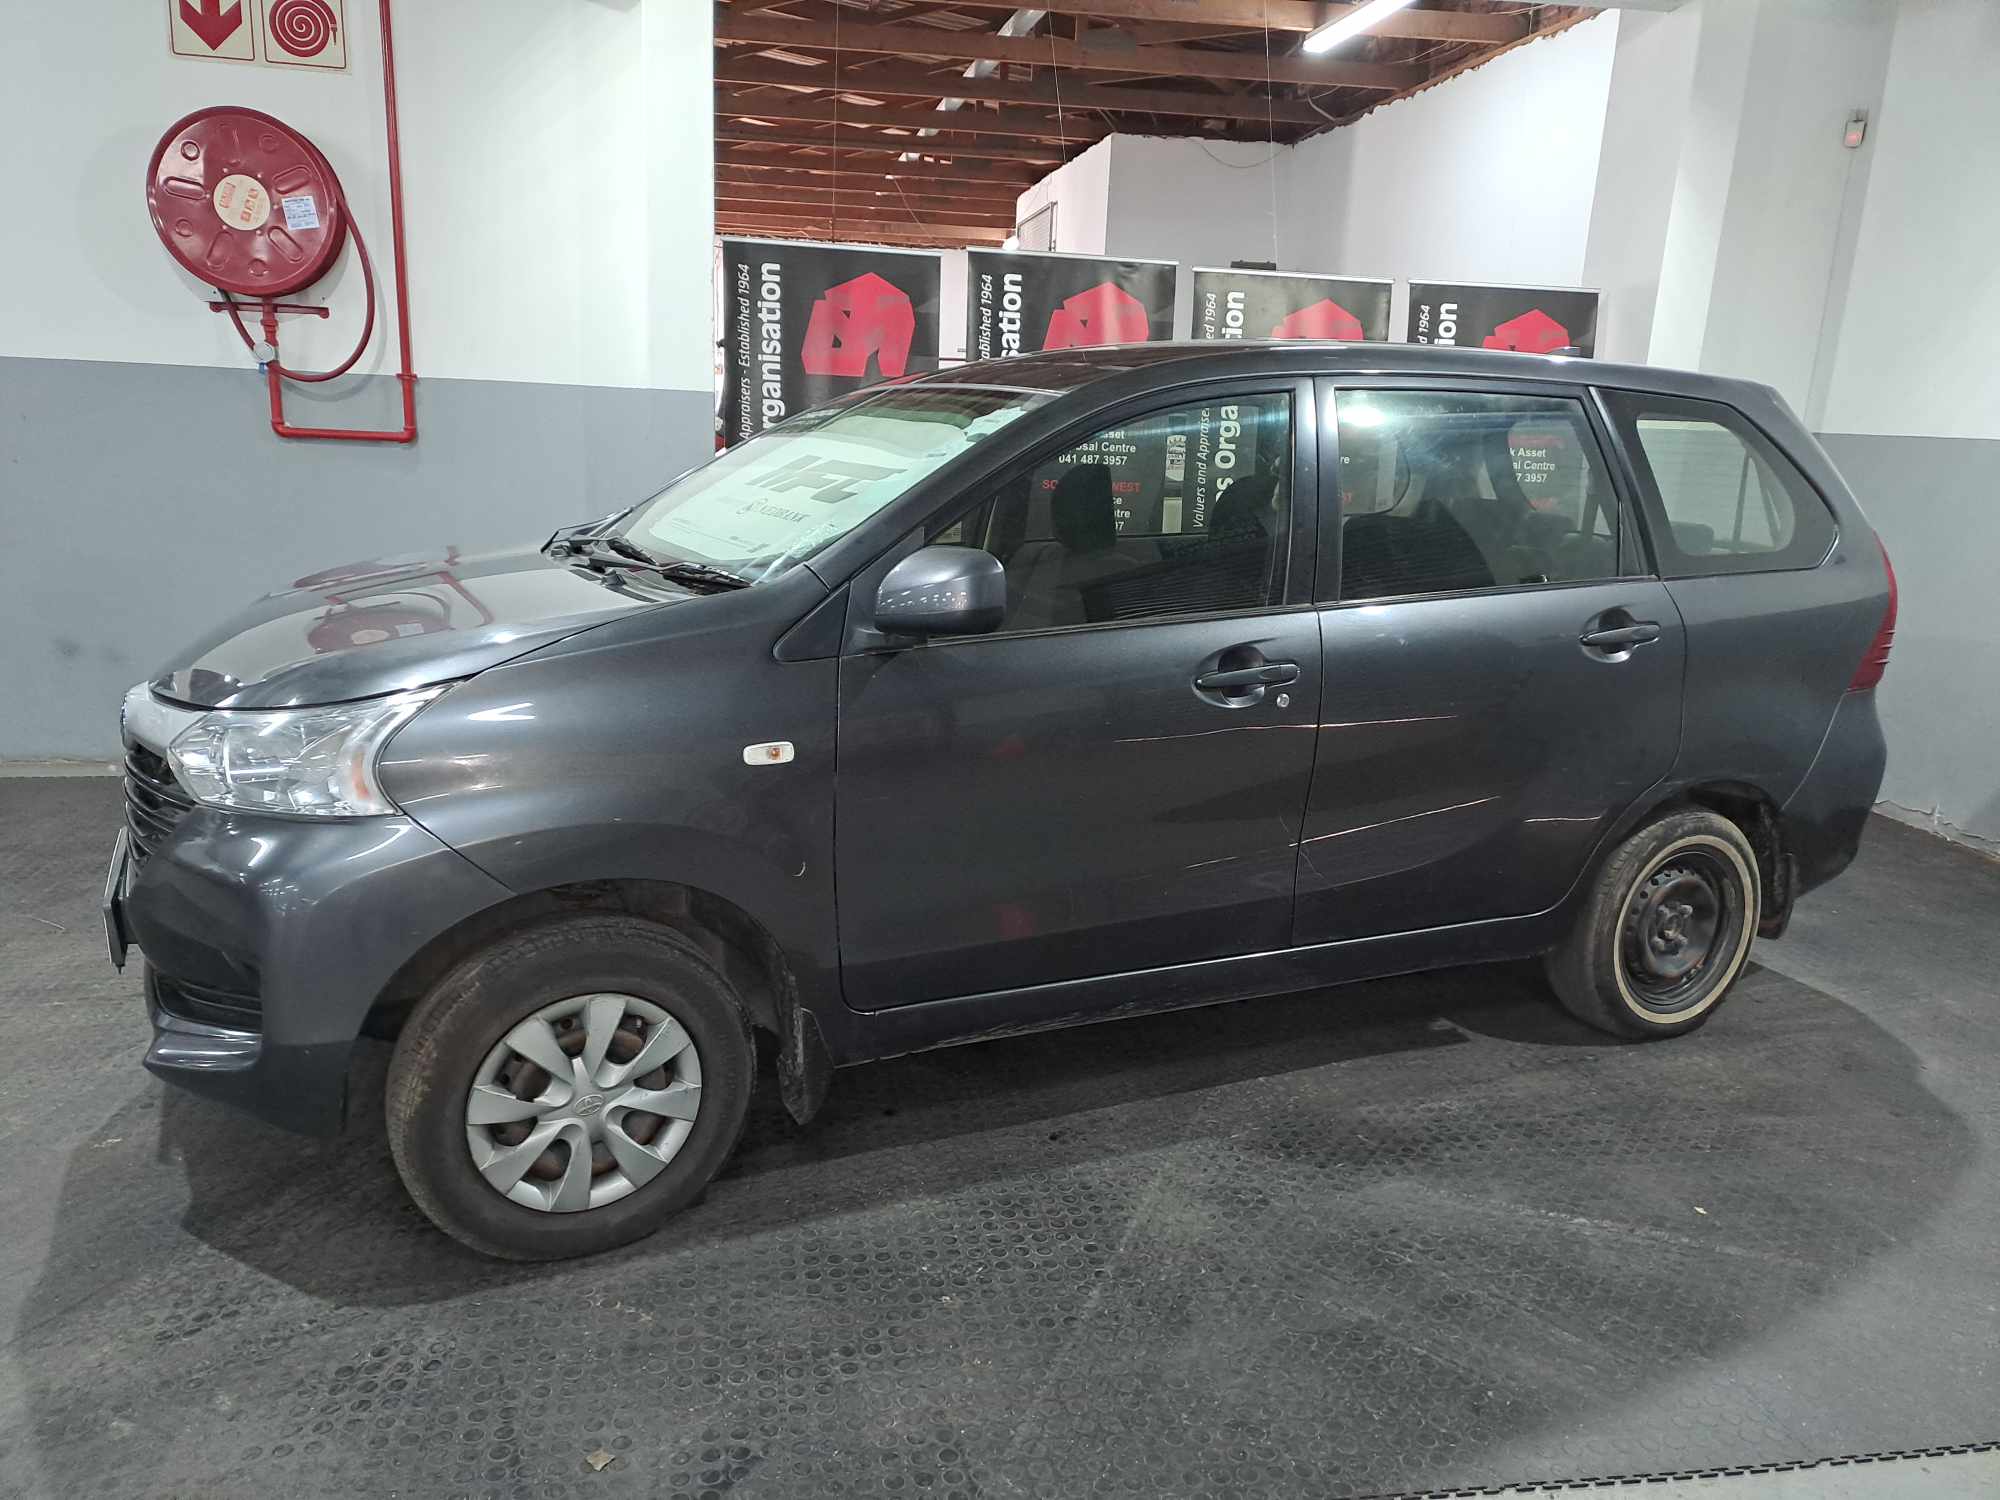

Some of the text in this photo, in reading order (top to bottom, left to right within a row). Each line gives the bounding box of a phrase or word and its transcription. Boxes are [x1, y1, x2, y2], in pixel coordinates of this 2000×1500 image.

[737, 263, 750, 294] 1964
[980, 273, 993, 304] 1964
[1205, 293, 1216, 321] 1964
[1419, 304, 1430, 333] 1964
[737, 296, 750, 367] Established
[738, 377, 754, 440] Appraisers
[1080, 454, 1100, 465] 487
[1102, 455, 1128, 466] 3957
[1101, 441, 1136, 453] Centre
[1517, 447, 1547, 458] Asset
[1192, 407, 1212, 528] Valuers and Appraise
[1523, 460, 1556, 471] Centre
[1524, 473, 1547, 483] 3957
